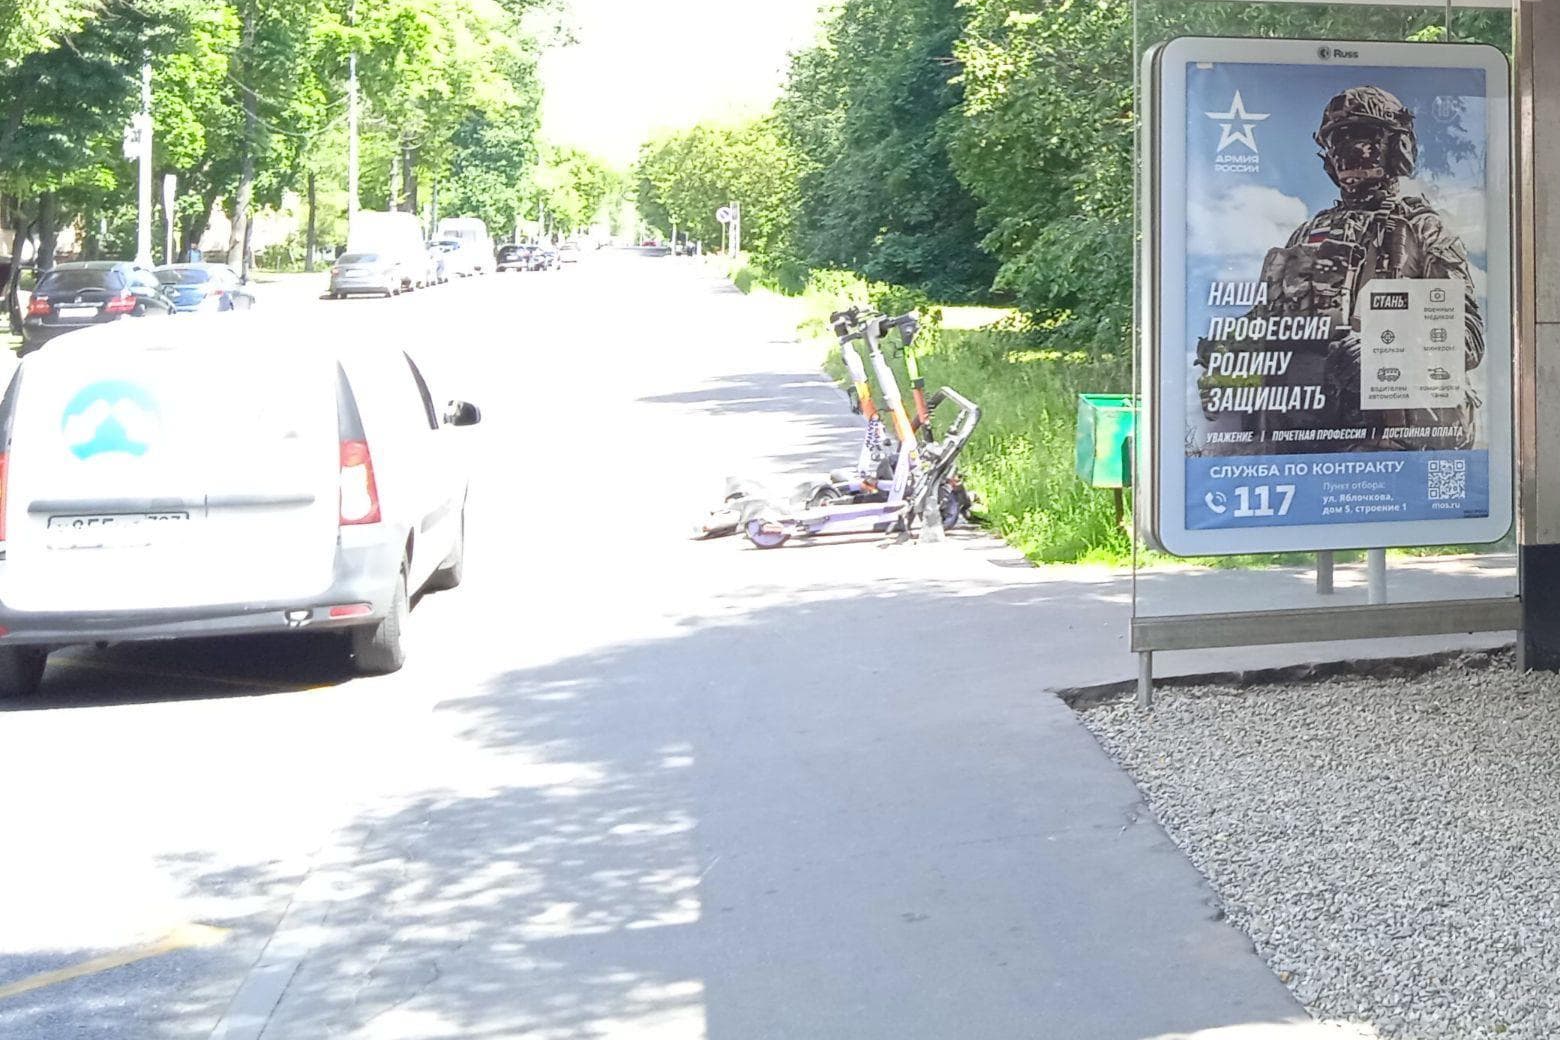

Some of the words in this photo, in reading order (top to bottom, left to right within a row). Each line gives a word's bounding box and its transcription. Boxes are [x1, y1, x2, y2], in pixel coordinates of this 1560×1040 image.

[1333, 48, 1359, 59] Russ
[1215, 155, 1259, 164] АРМИЯ
[1215, 164, 1259, 173] РОССИИ
[1208, 281, 1268, 306] НАША
[1208, 316, 1331, 341] ПРОФЕССИЯ
[1208, 351, 1293, 379] РОДИНУ
[1208, 385, 1326, 414] ЗАЩИЩАТЬ
[1206, 431, 1254, 443] УВАЖЕНИЕ
[1272, 430, 1315, 441] ПОЧЕТНАЯ
[1316, 427, 1367, 440] ПРОФЕССИЯ
[1382, 426, 1430, 440] ДОСТОЙНАЯ
[1431, 426, 1463, 438] ОПЛАТА
[1210, 464, 1280, 478] СЛУЖБА
[1284, 463, 1308, 476] ПО
[1312, 461, 1405, 475] КОНТРАКТУ
[1234, 484, 1296, 517] 117
[1322, 496, 1337, 505] ул.
[1431, 502, 1461, 510] mos.ru
[1322, 507, 1342, 515] дом
[1355, 504, 1400, 514] строение
